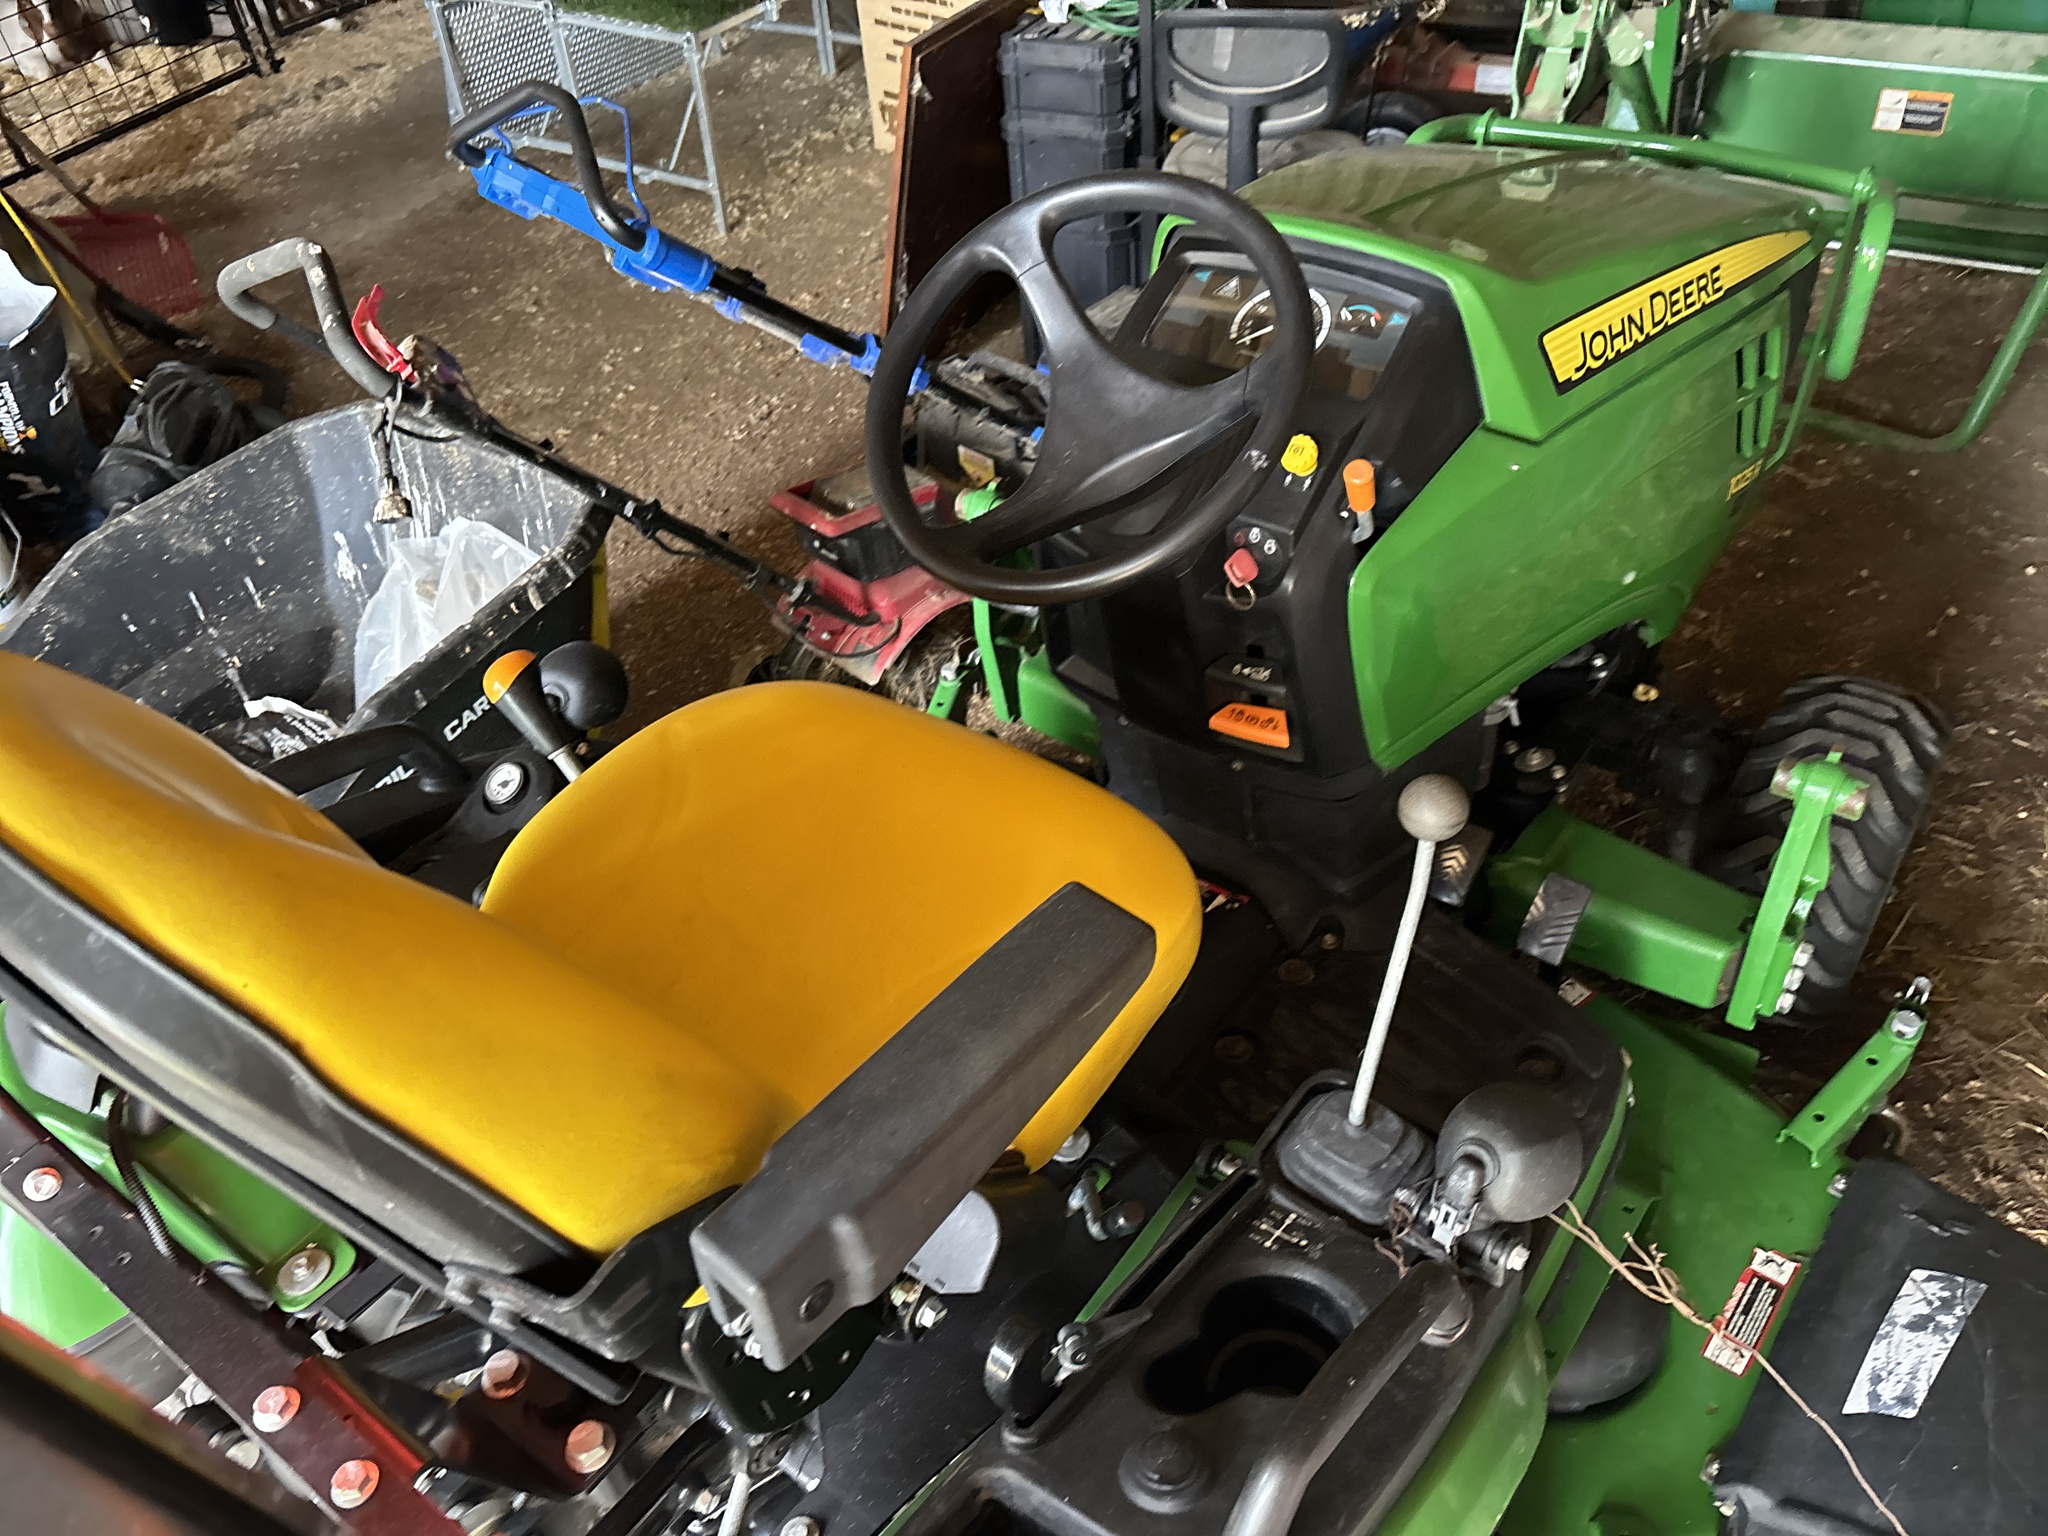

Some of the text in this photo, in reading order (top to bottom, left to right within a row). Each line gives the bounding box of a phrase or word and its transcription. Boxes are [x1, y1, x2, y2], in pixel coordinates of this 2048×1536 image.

[1574, 264, 1725, 373] JOHN DEERE
[0, 392, 25, 454] AMPIONS
[443, 695, 491, 742] CAR
